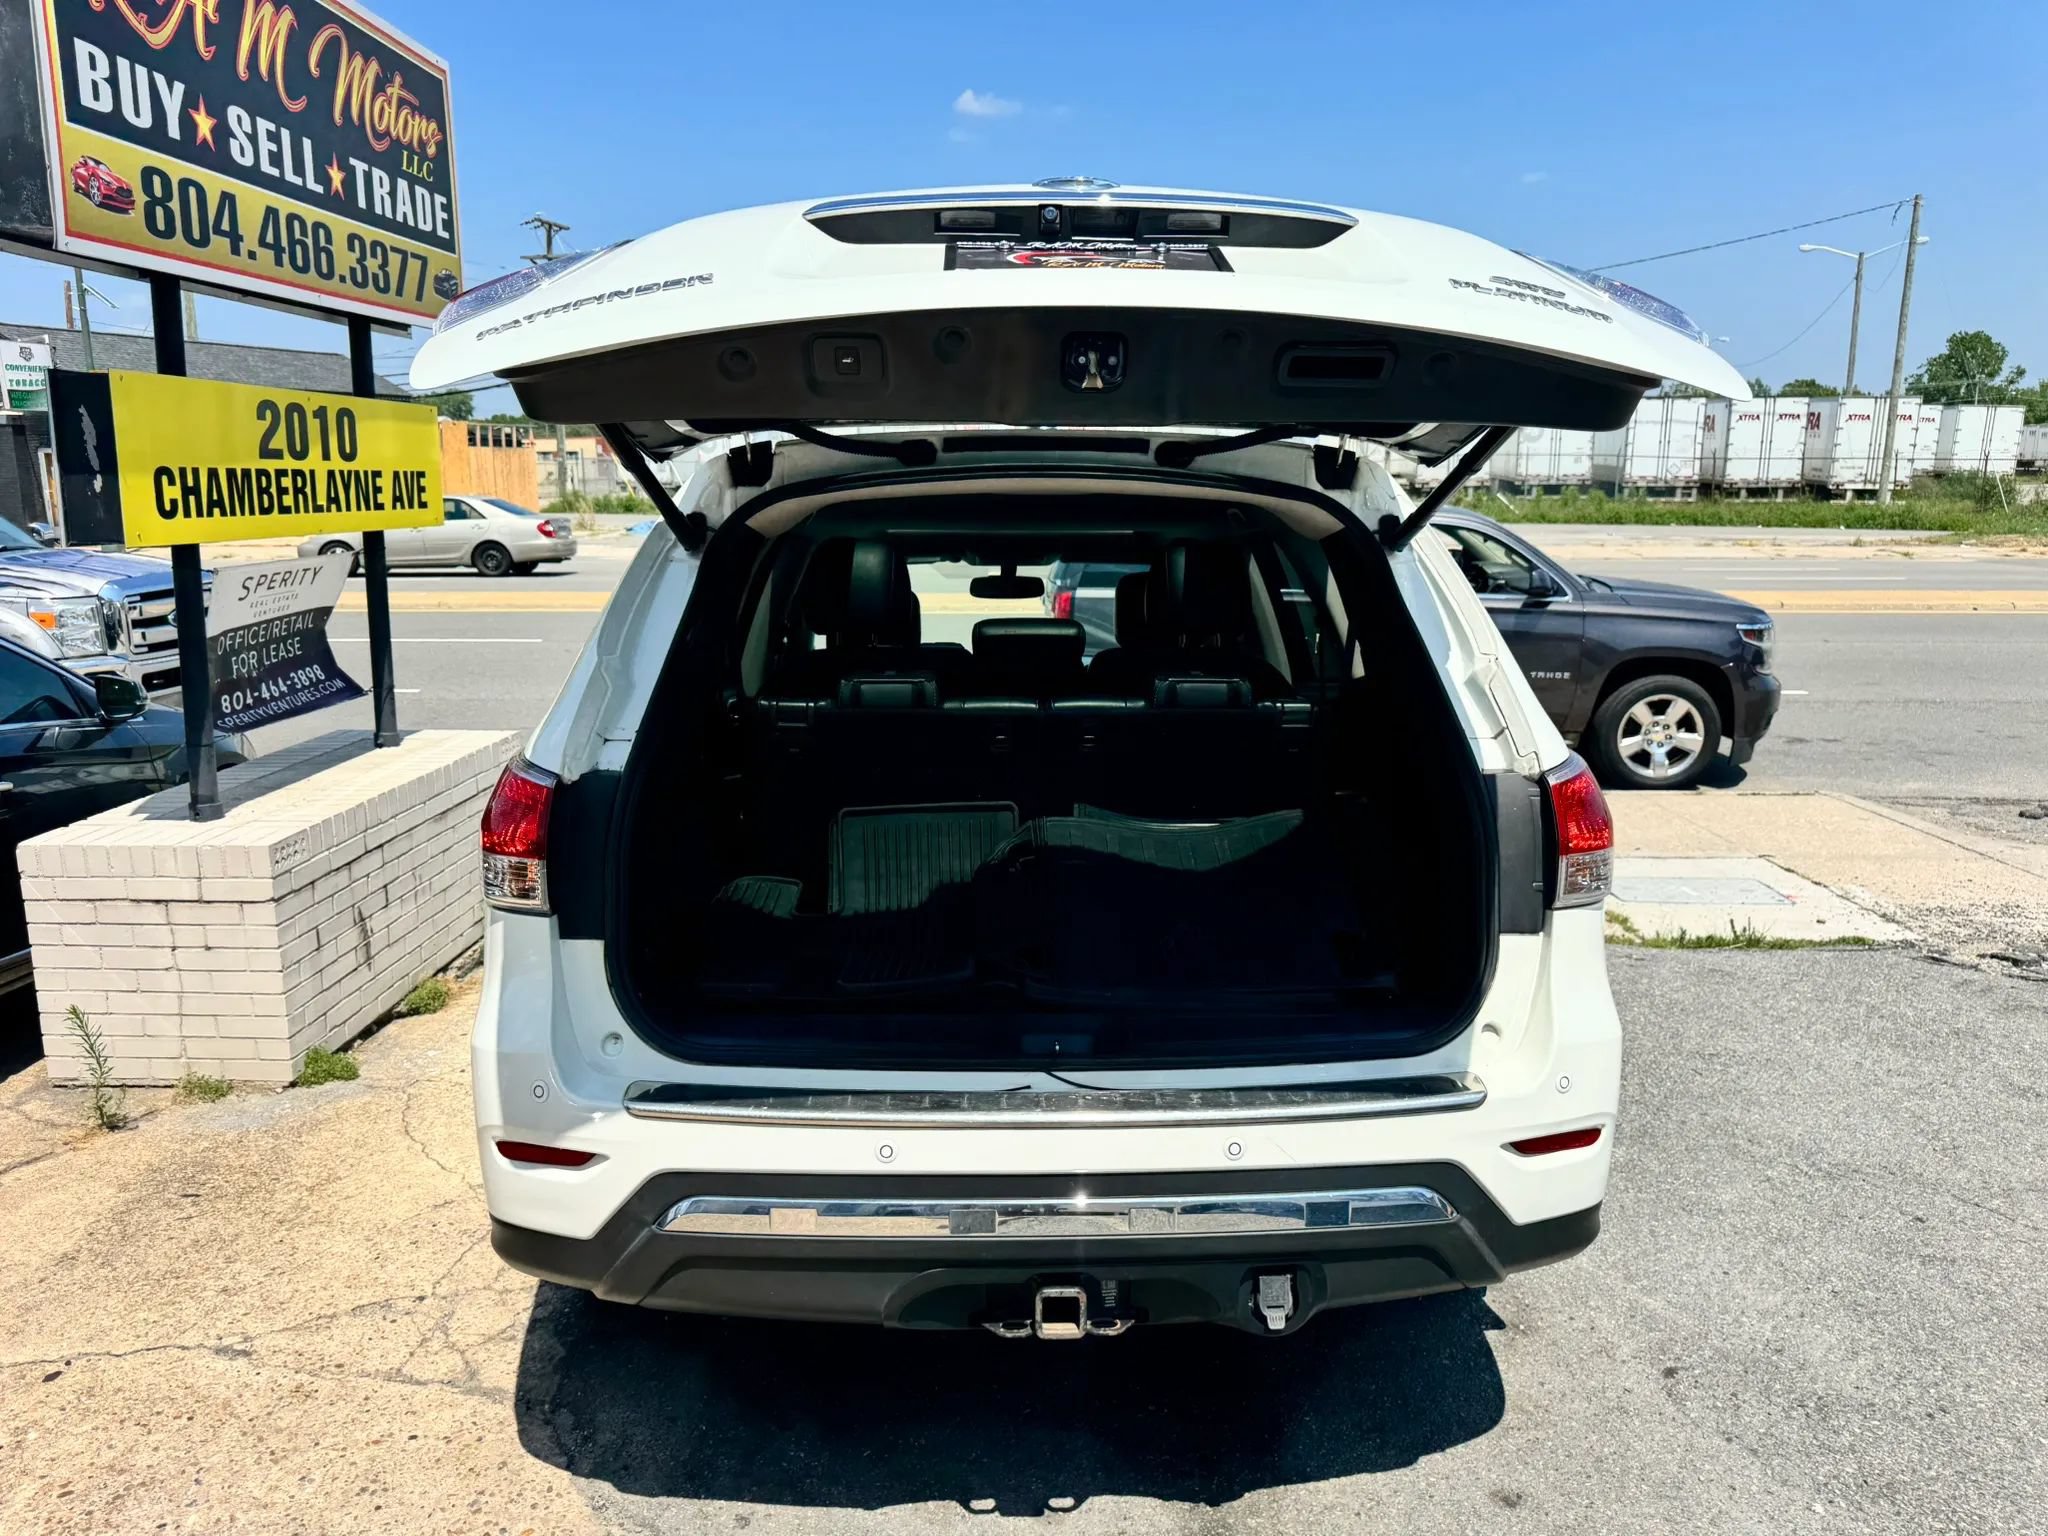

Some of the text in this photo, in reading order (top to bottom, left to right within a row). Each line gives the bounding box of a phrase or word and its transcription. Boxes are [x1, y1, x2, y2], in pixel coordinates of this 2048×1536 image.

[308, 23, 443, 158] Motors
[73, 37, 450, 239] BUY SELL TRADE
[401, 150, 434, 183] LLC
[140, 165, 428, 302] 804.466.3377
[256, 399, 358, 462] 2010
[1736, 413, 1760, 422] XTRA
[1776, 413, 1801, 422] XTRA
[1845, 413, 1871, 423] XTRA
[153, 465, 429, 520] CHAMBERLAYNE AVE
[238, 566, 324, 602] SPERITY
[217, 612, 315, 656] OFFICE/RETAIL
[231, 651, 258, 679] FOR
[263, 637, 303, 666] LEASE
[1530, 671, 1571, 680] TAHOE
[217, 678, 346, 730] SPERITYVENTURES.COM
[221, 664, 326, 714] 804-464-3898
